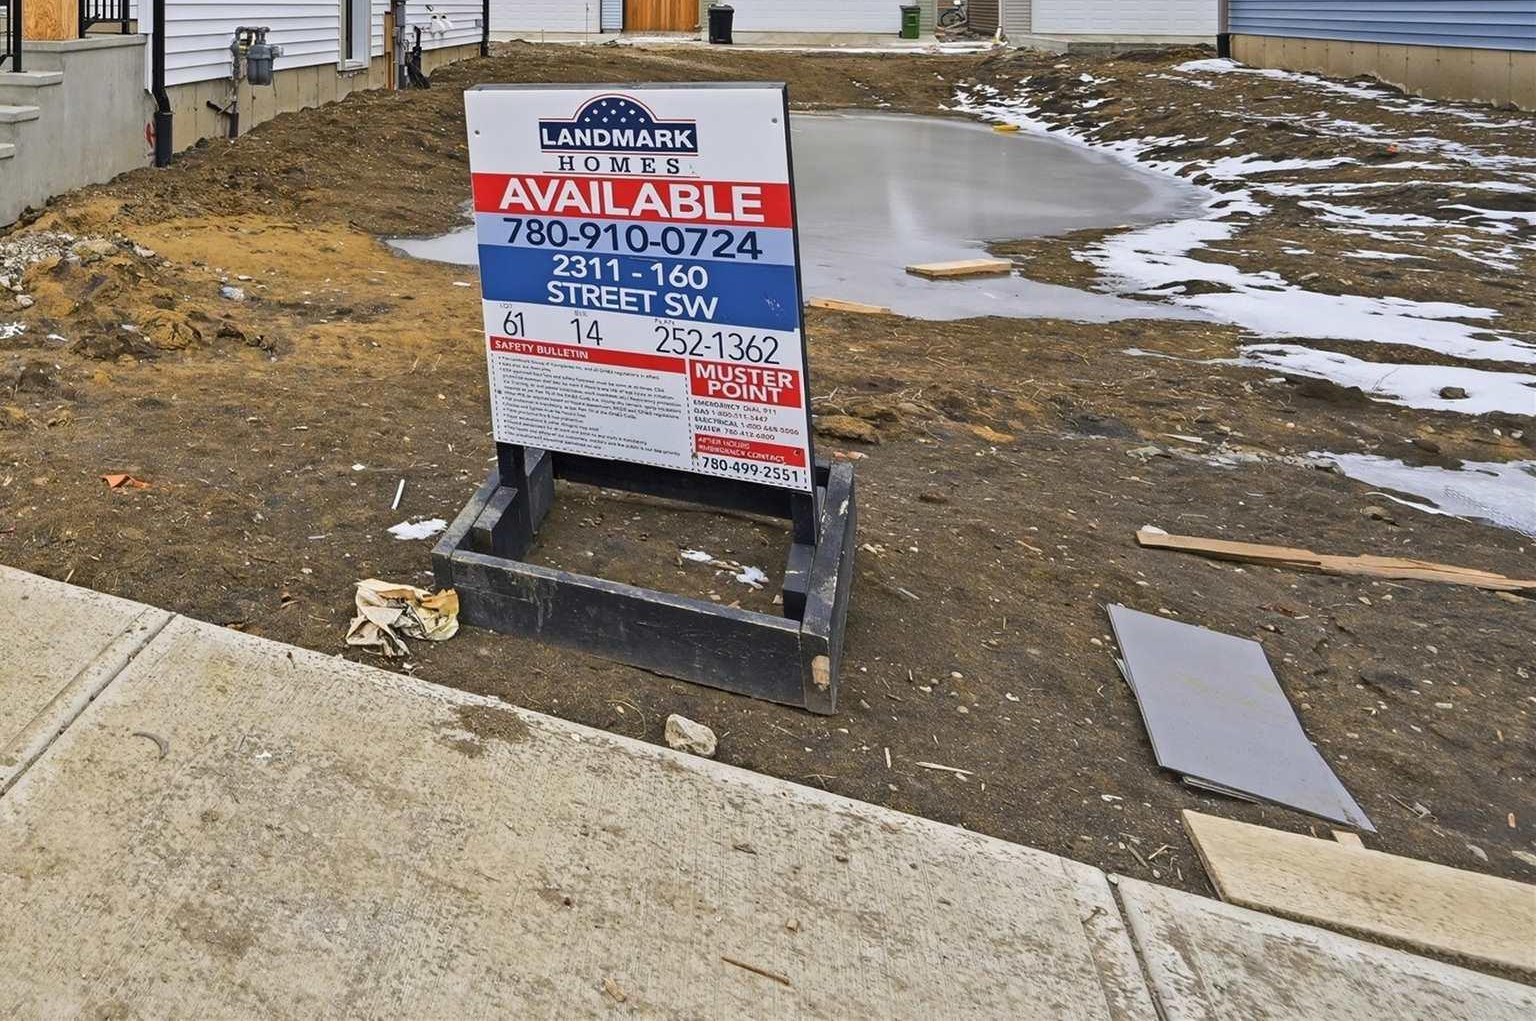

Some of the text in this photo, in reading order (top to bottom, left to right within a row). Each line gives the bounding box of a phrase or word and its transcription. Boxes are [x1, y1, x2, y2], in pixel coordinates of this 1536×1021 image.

[542, 128, 695, 149] LANDMARK
[557, 155, 680, 174] HOMES
[499, 177, 765, 223] AVAILABLE
[503, 217, 763, 260] 780-910-0724
[552, 254, 620, 282] 2311
[651, 262, 709, 290] 160
[547, 281, 719, 320] STREET SW
[495, 339, 589, 360] SAFETY BULLETIN
[502, 310, 780, 365] 61 14 252-1362
[695, 362, 794, 389] MUSTER
[707, 380, 782, 403] POINT
[702, 456, 798, 483] 780-499-2551
